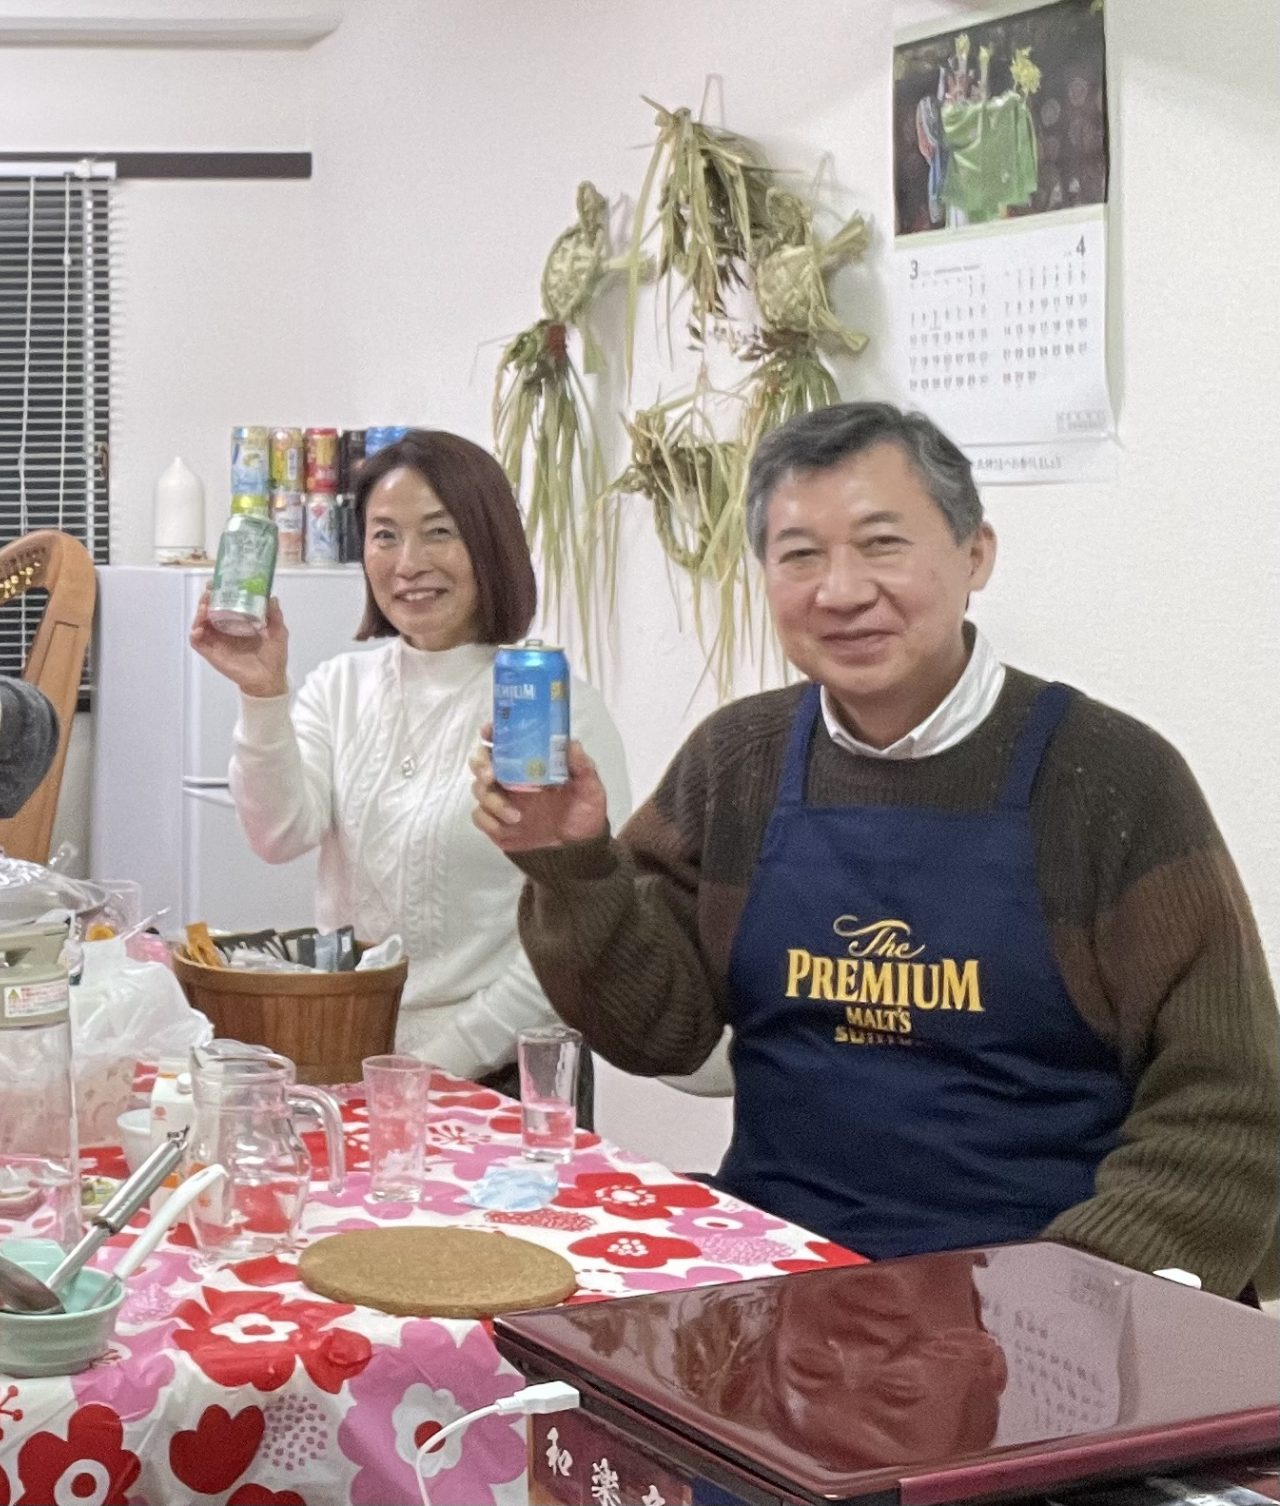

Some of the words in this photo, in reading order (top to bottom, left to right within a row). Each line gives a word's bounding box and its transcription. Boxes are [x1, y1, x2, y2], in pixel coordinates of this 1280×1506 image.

[1075, 235, 1086, 257] 4
[909, 259, 919, 281] 3
[832, 914, 926, 958] The
[784, 948, 986, 1012] PREMIUM
[845, 1006, 913, 1034] MALT'S
